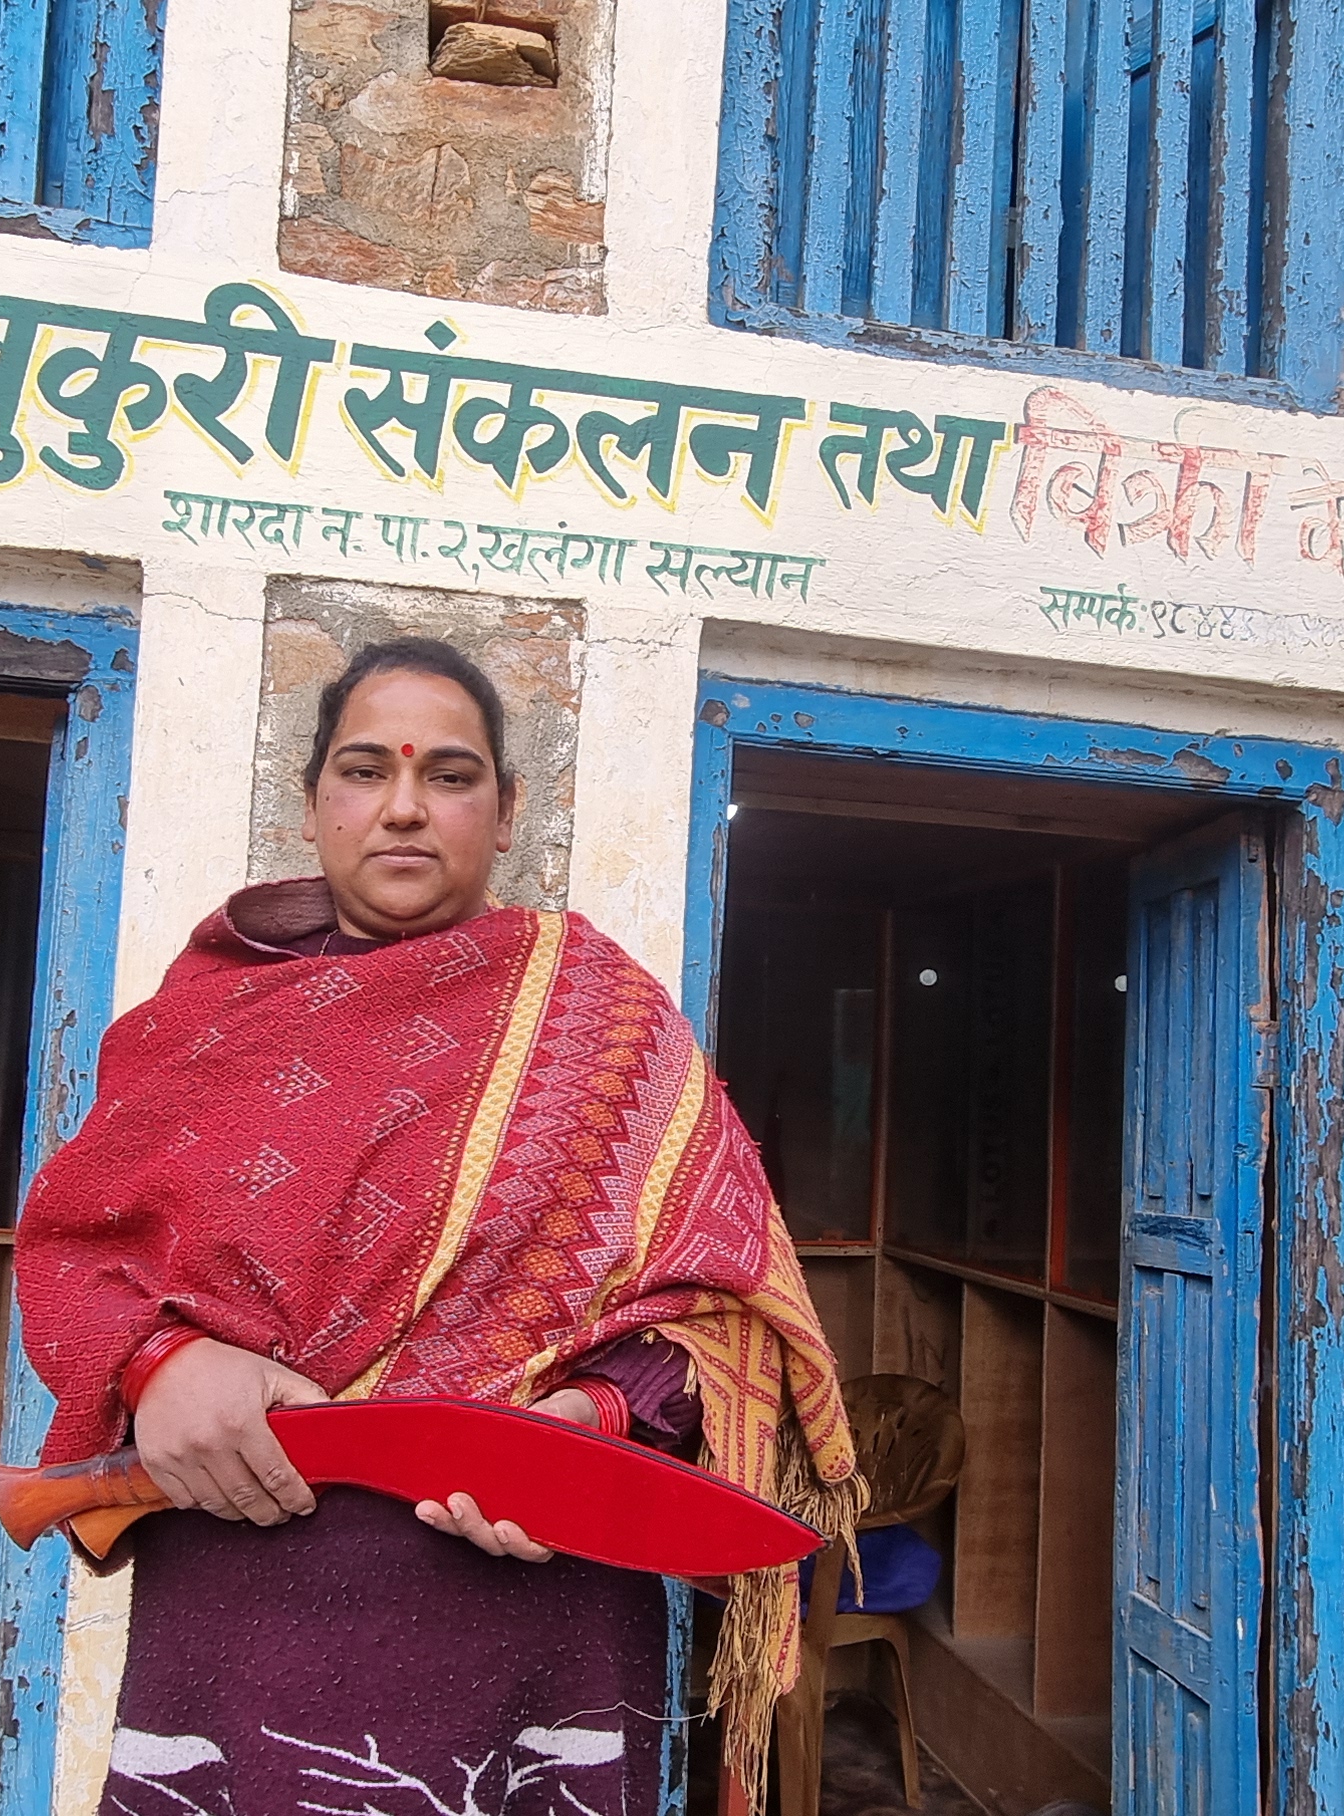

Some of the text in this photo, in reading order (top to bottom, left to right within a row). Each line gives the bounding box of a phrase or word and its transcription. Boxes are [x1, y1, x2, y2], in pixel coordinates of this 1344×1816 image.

[343, 319, 805, 513] संकलन
[817, 400, 1005, 521] तथा
[161, 489, 315, 557] शारदा
[373, 513, 430, 563] पा.
[644, 540, 827, 605] सल्यान
